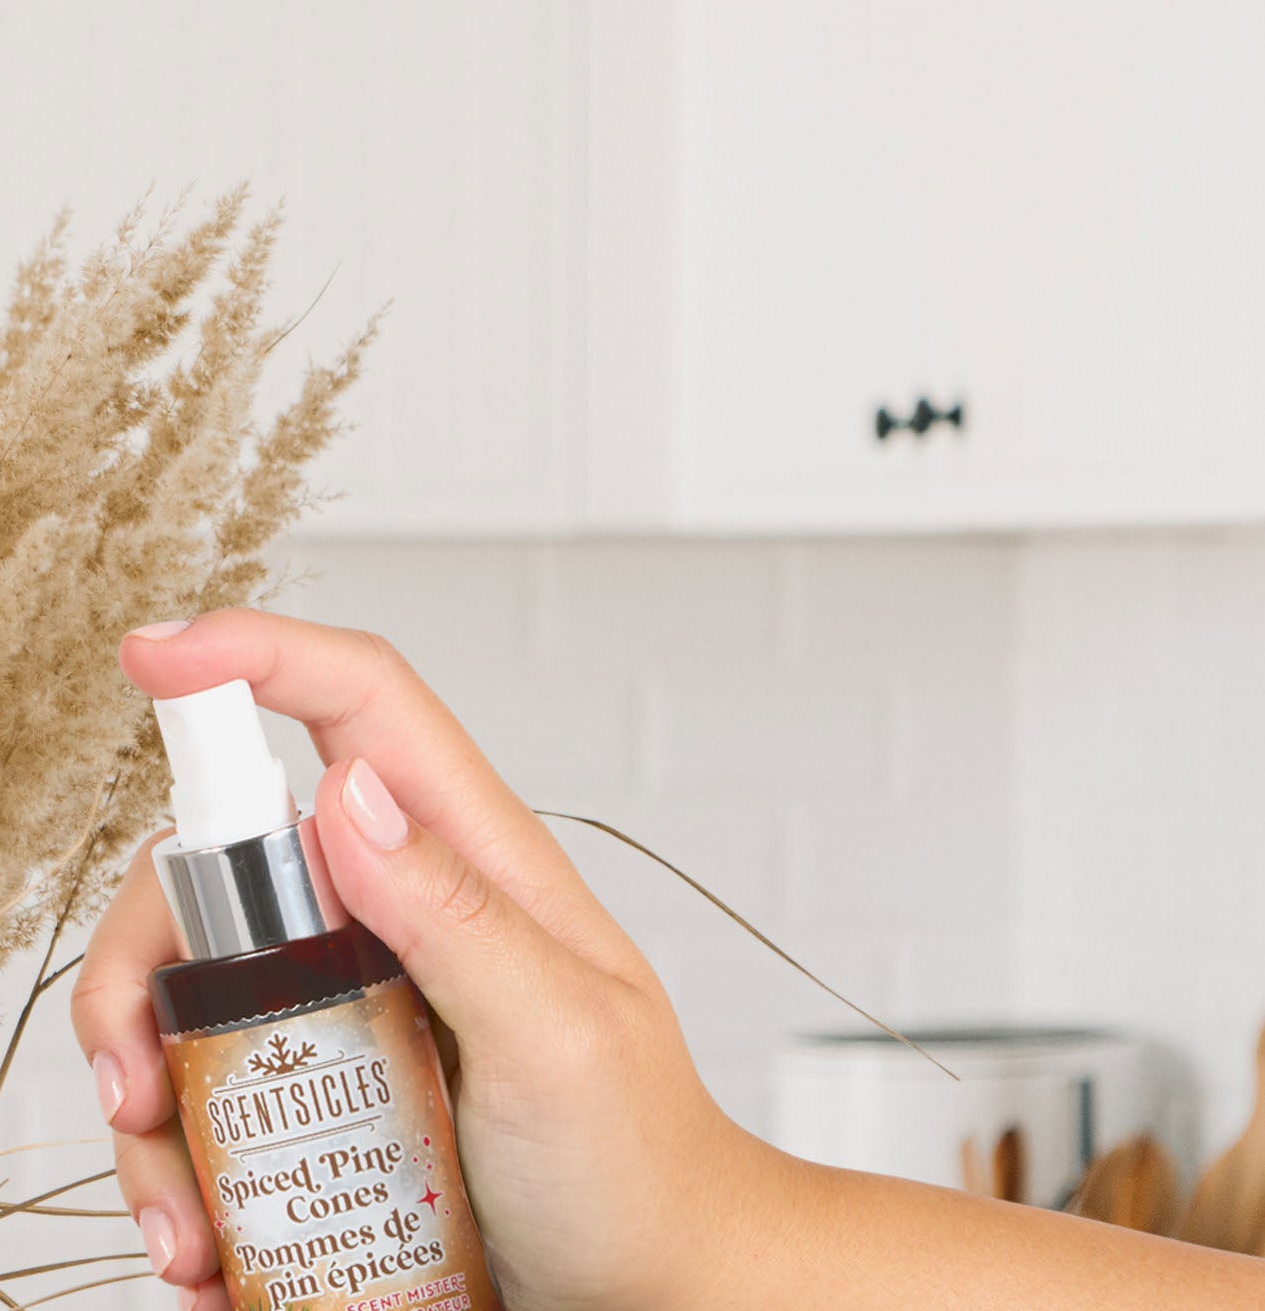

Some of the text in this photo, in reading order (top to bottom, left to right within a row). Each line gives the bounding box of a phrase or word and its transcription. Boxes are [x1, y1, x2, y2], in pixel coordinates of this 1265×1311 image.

[209, 1060, 391, 1144] SCENTSICLES
[218, 1142, 402, 1209] Spiced Pine
[286, 1181, 389, 1224] Cones
[236, 1208, 421, 1271] Pommes de
[267, 1240, 444, 1310] pin épicées
